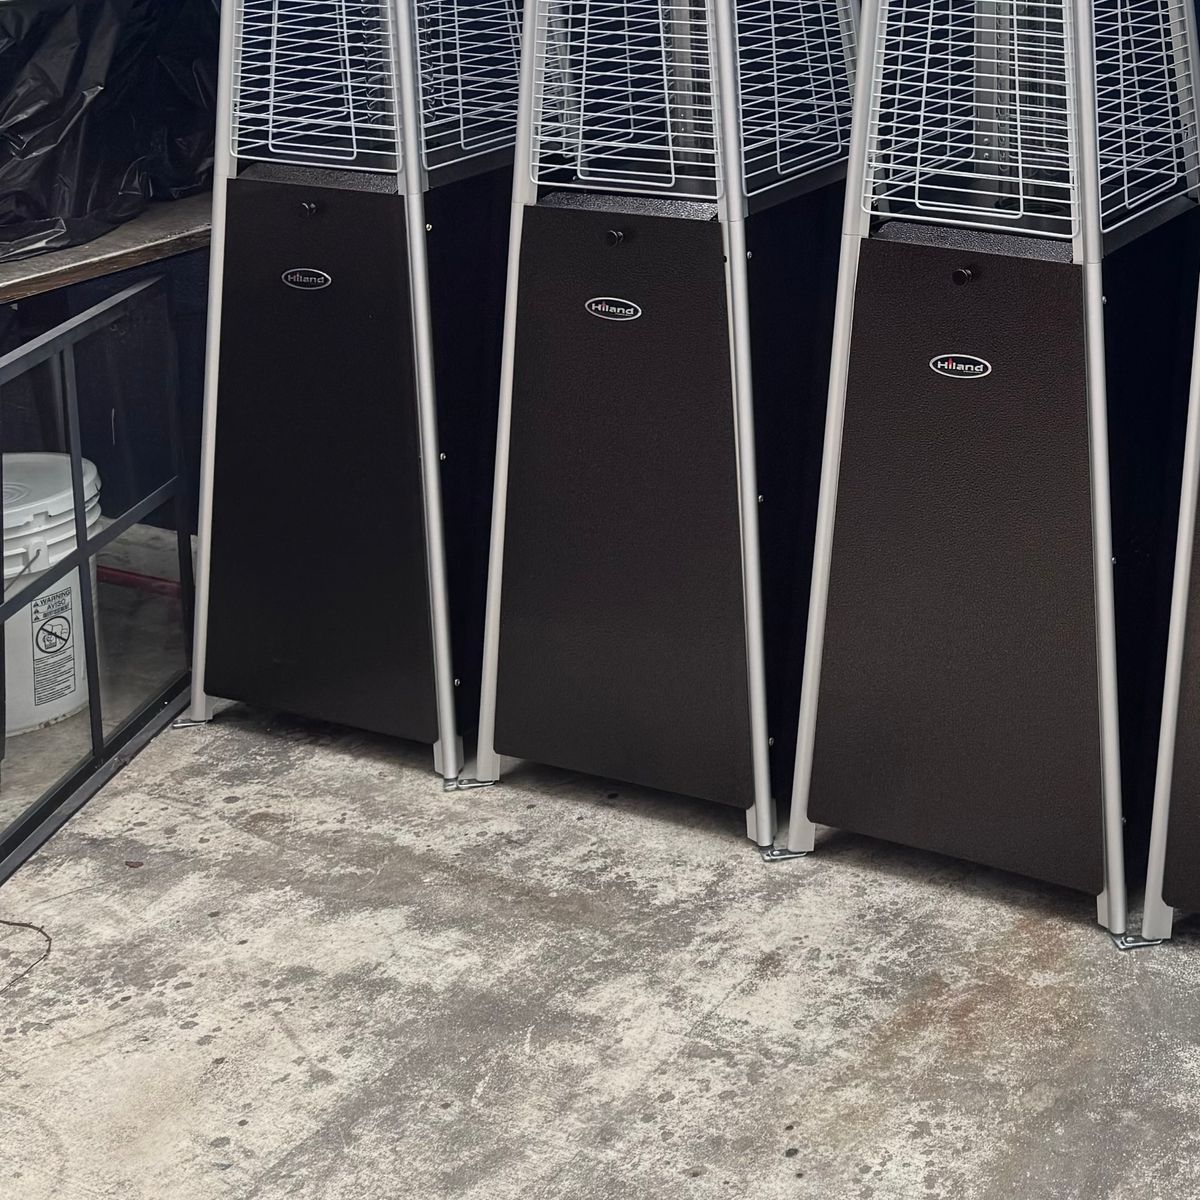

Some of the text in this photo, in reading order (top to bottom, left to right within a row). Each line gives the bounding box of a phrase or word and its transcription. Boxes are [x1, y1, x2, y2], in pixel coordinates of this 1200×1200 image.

[287, 272, 325, 283] Hiland
[591, 301, 635, 315] Hiland
[937, 358, 984, 372] Hiland
[40, 589, 71, 605] WARNING
